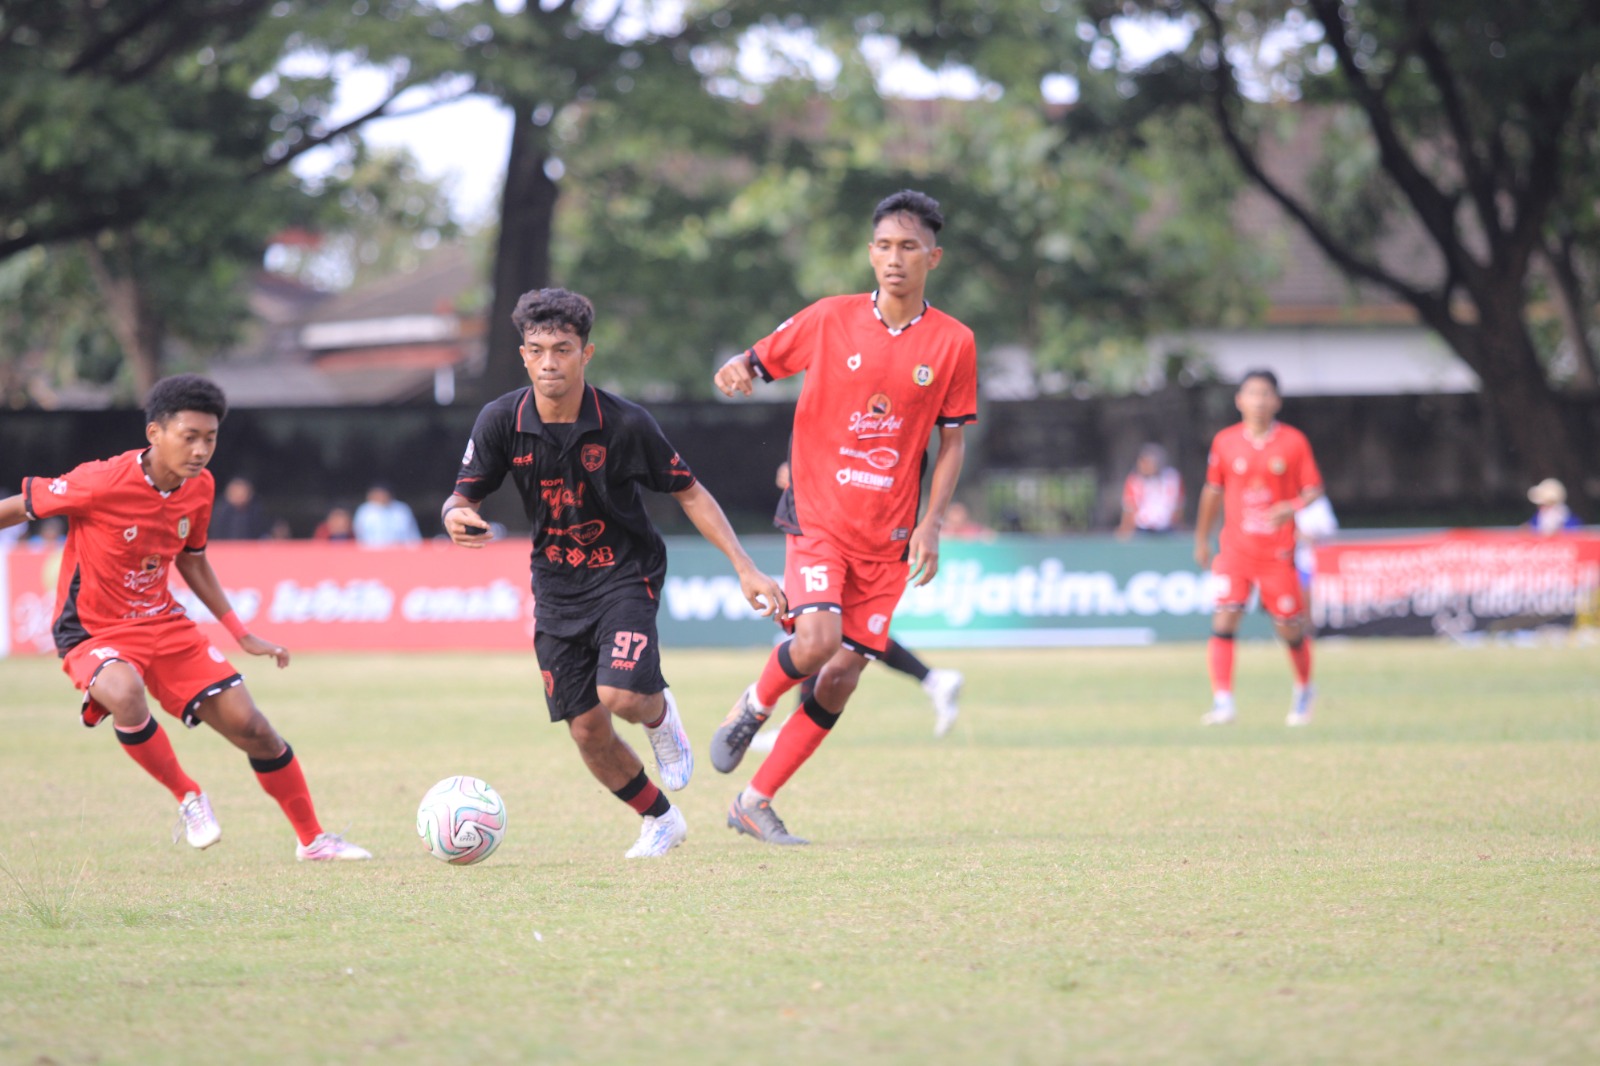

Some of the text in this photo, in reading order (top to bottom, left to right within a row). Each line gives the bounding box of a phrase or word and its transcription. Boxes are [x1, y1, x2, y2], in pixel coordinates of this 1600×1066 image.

[541, 478, 563, 487] KOPI
[587, 546, 614, 565] AB
[800, 565, 828, 592] 15
[611, 631, 648, 661] 97
